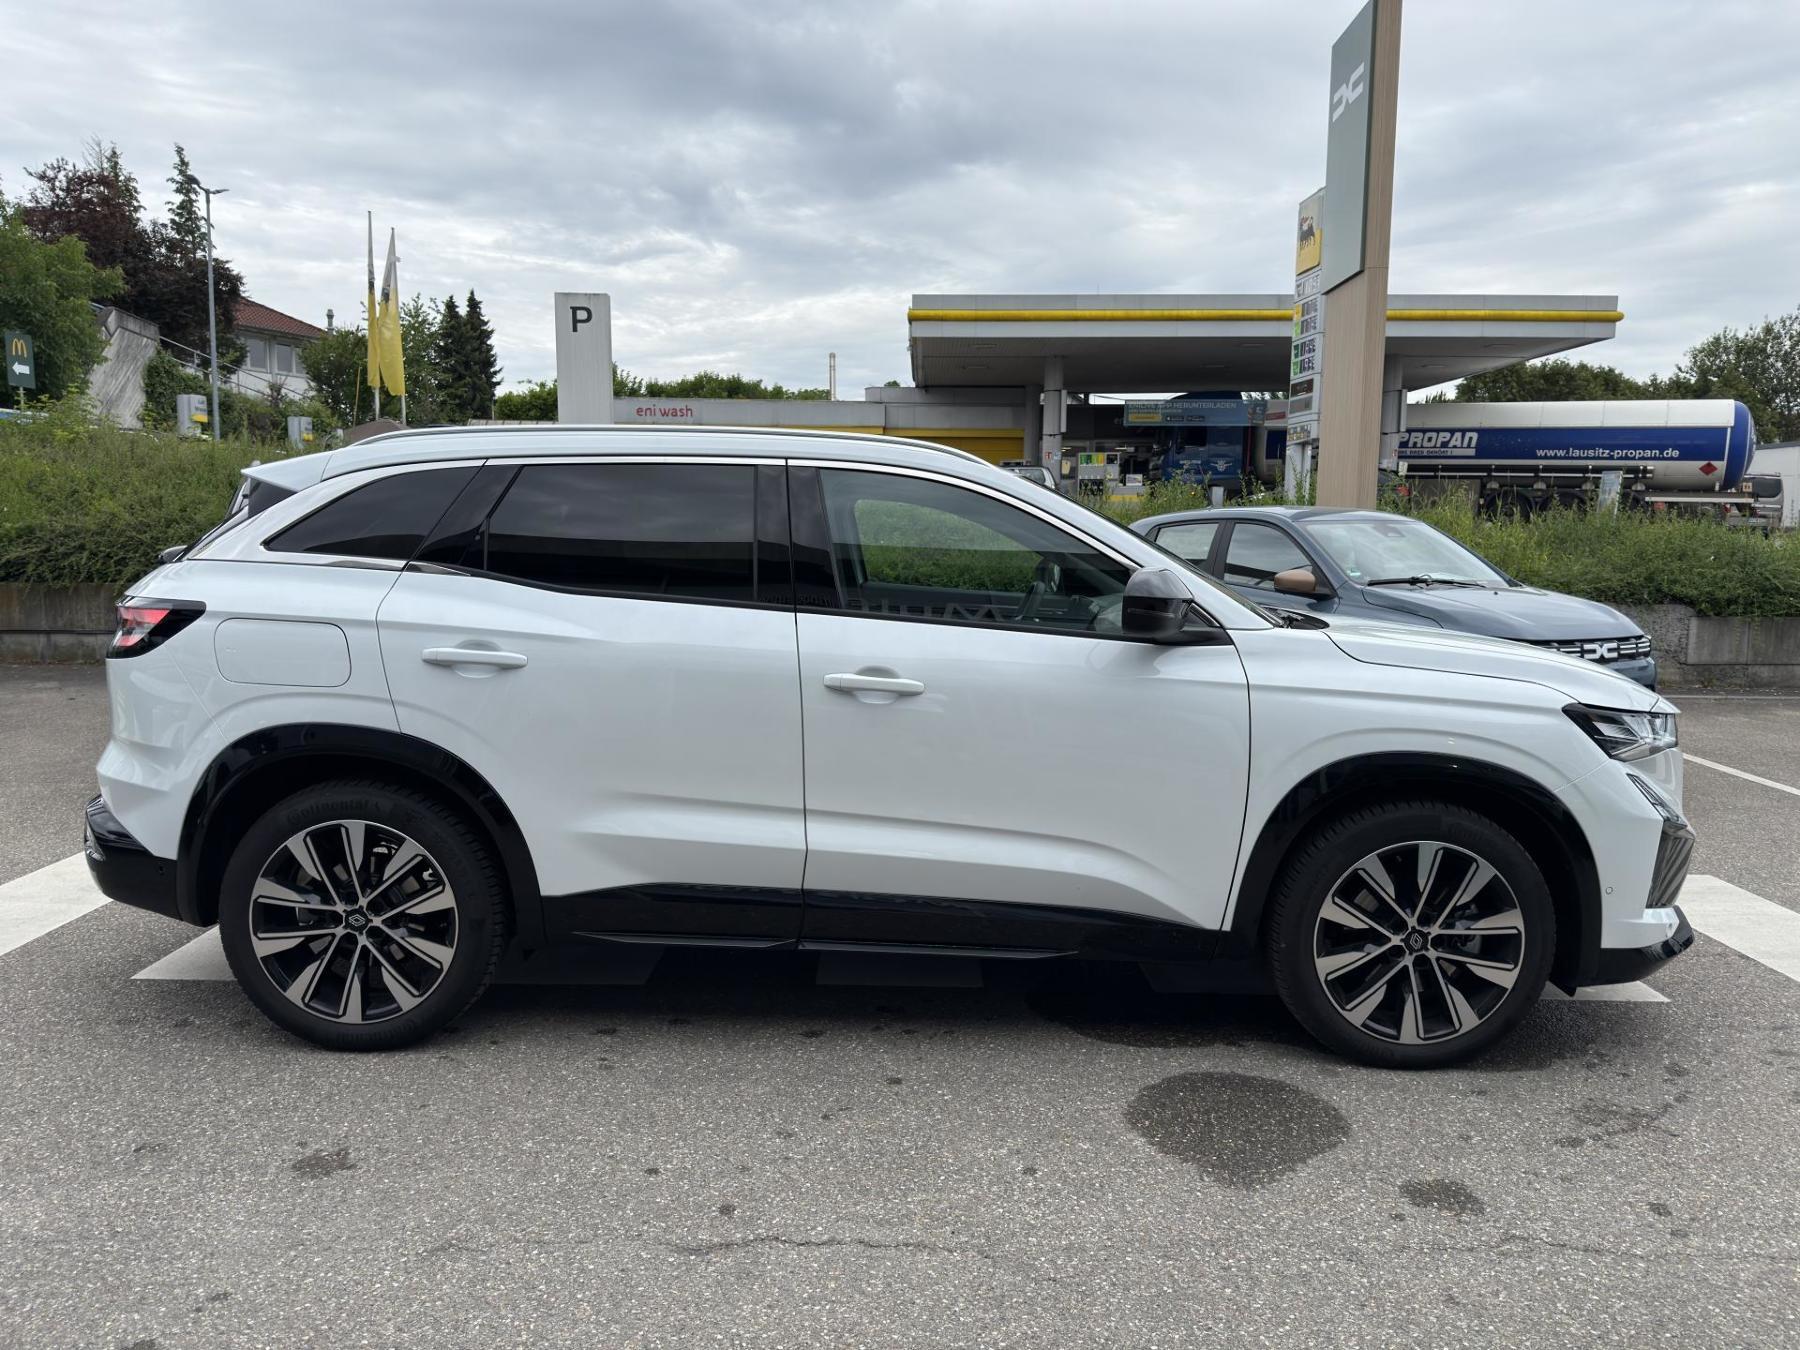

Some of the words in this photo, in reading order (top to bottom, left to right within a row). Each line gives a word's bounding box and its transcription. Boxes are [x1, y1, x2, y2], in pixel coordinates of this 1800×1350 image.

[570, 306, 592, 332] P
[636, 404, 656, 417] eni
[659, 404, 693, 417] wash
[1397, 431, 1479, 448] PROPAN
[1536, 447, 1680, 459] www.lausitz-propan.de
